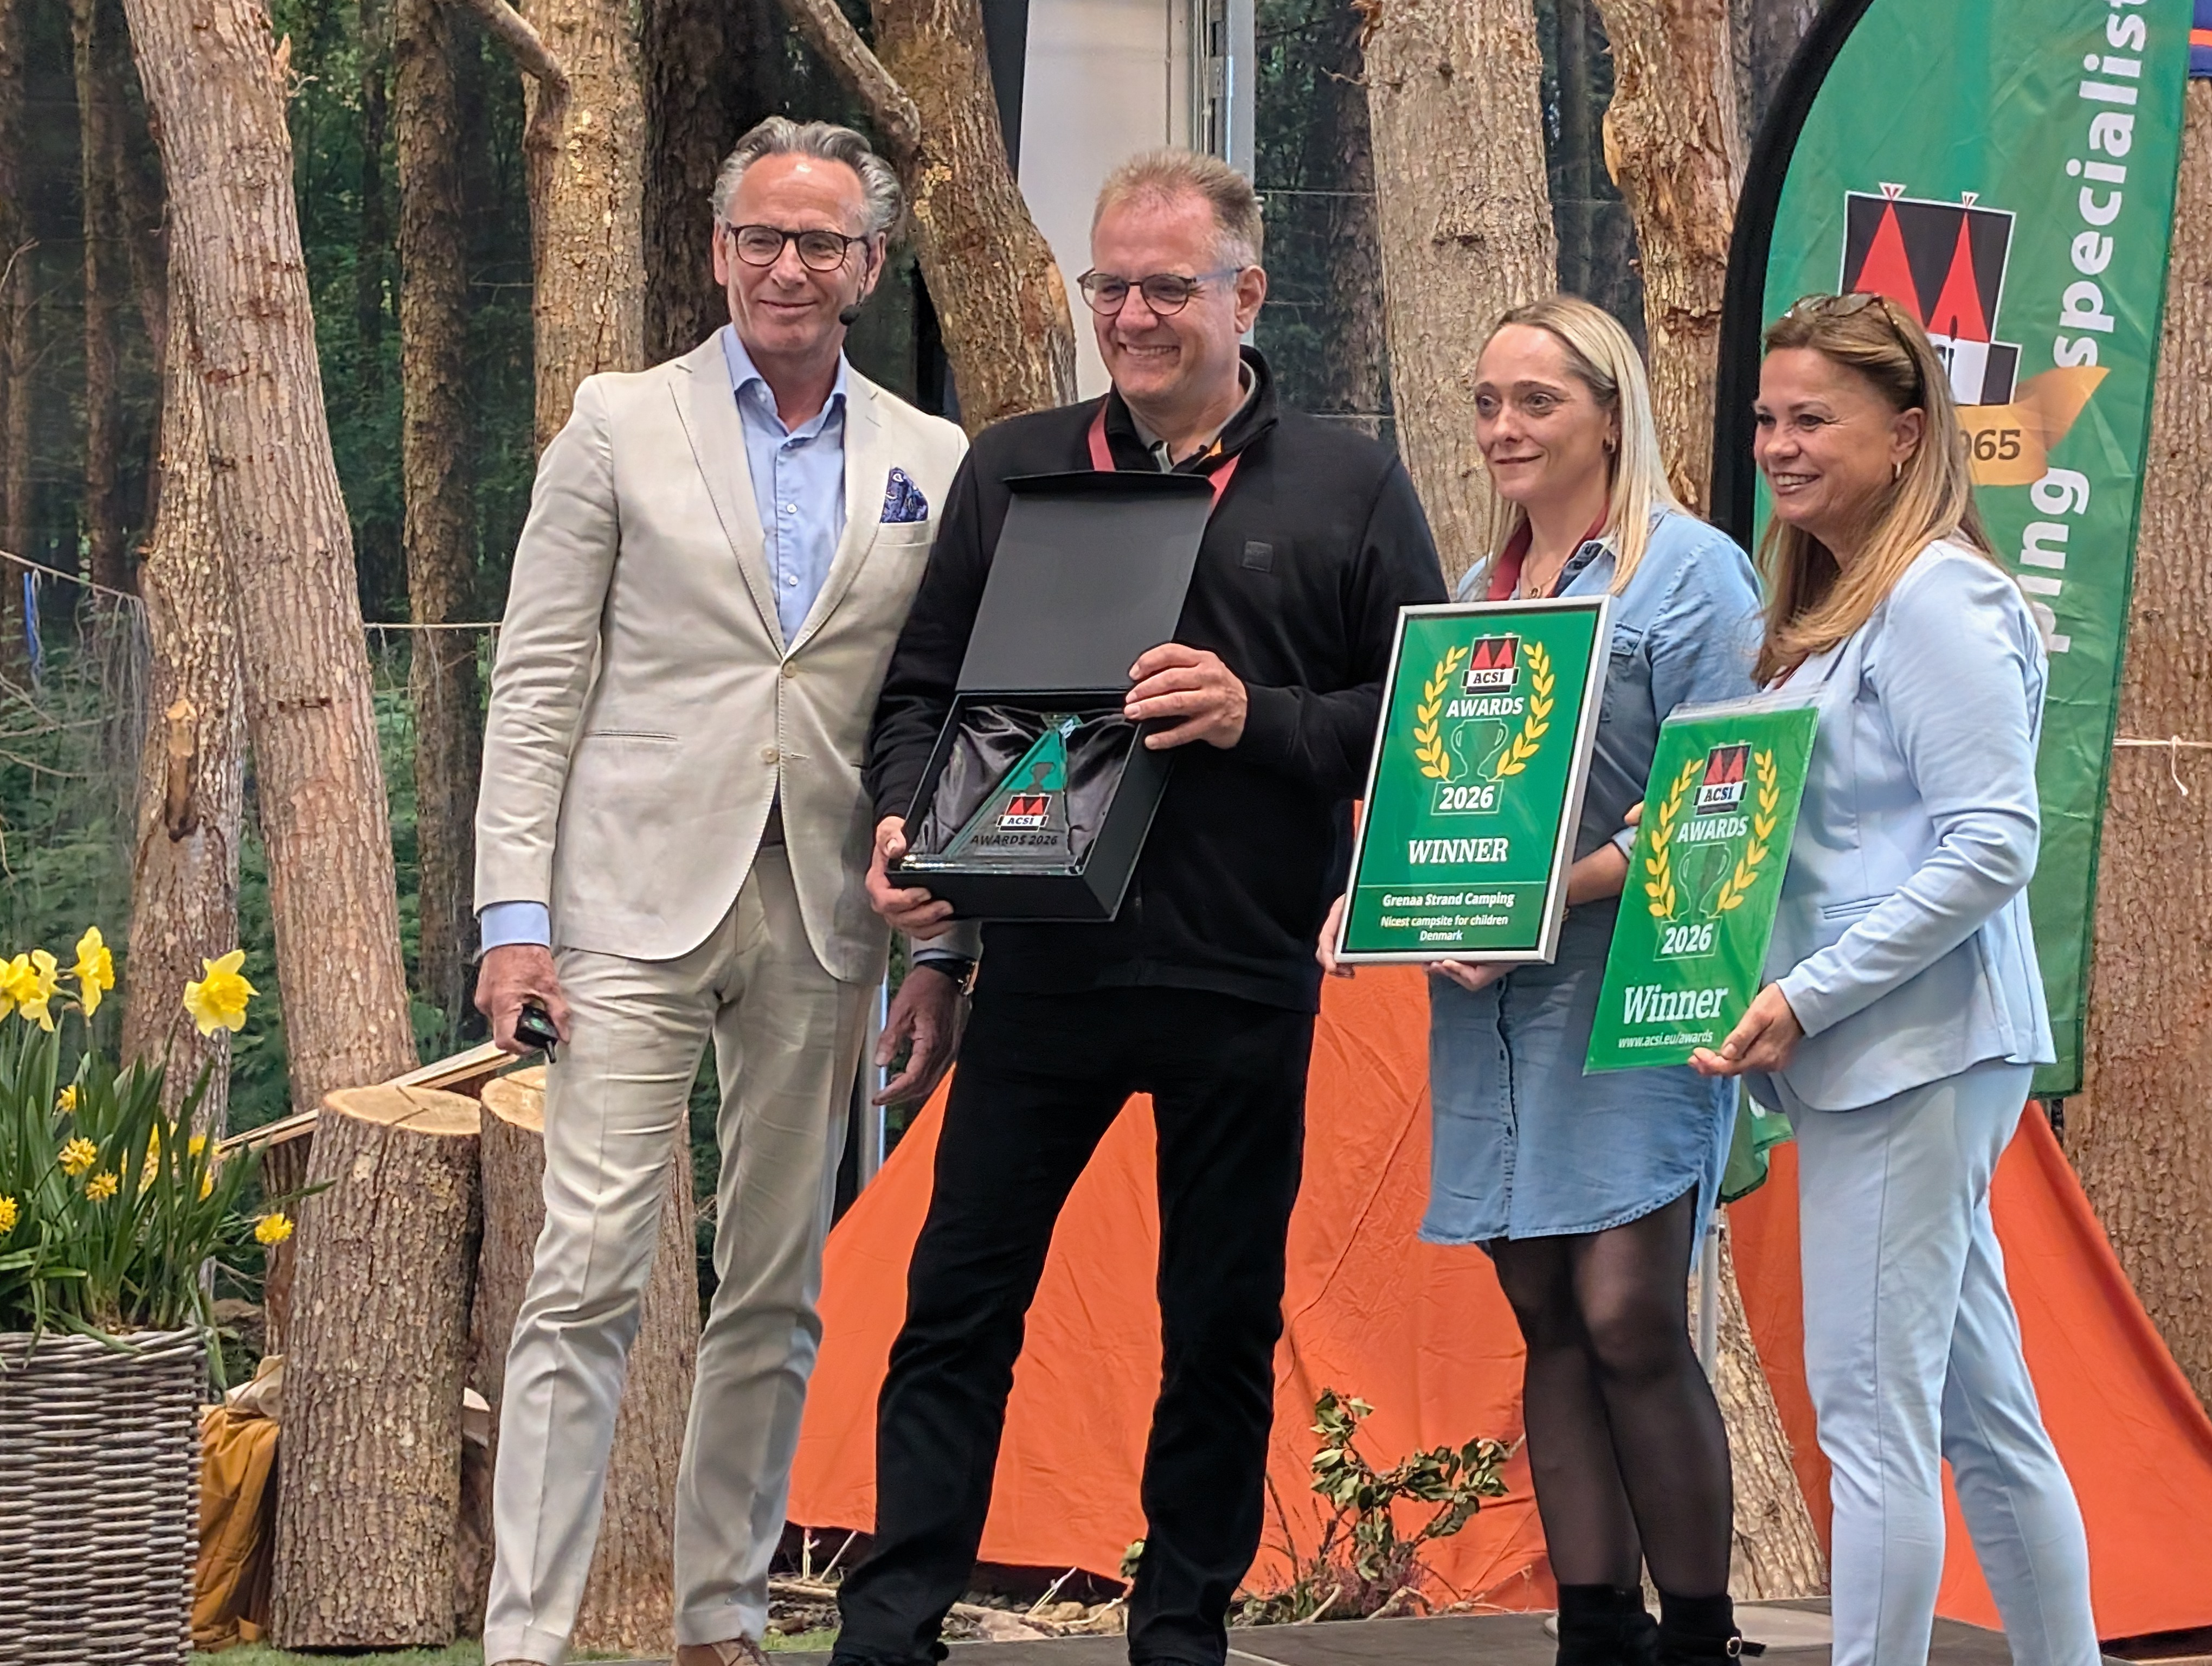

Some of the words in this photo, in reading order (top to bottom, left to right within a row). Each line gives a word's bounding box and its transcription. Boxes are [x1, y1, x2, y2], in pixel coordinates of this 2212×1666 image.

[2053, 0, 2147, 367] specialis
[1473, 672, 1504, 684] ACSI
[1446, 697, 1525, 718] AWARDS
[1439, 785, 1495, 809] 2026
[1704, 786, 1734, 802] ACSI
[1676, 816, 1749, 843] AWARDS
[970, 835, 1026, 845] AWARDS
[1028, 835, 1058, 845] 2026
[1409, 838, 1508, 864] WINNER
[1383, 894, 1423, 907] Grenaa
[1425, 893, 1463, 906] Strand
[1465, 892, 1515, 907] Camping
[1381, 916, 1410, 926] Nicest
[1411, 915, 1452, 928] campsite
[1454, 915, 1468, 925] for
[1470, 914, 1508, 925] children
[1419, 930, 1463, 941] Denmark
[1661, 924, 1712, 954] 2026
[1624, 984, 1728, 1024] Winner
[1618, 1029, 1713, 1048] www.acsi.eu/awards
